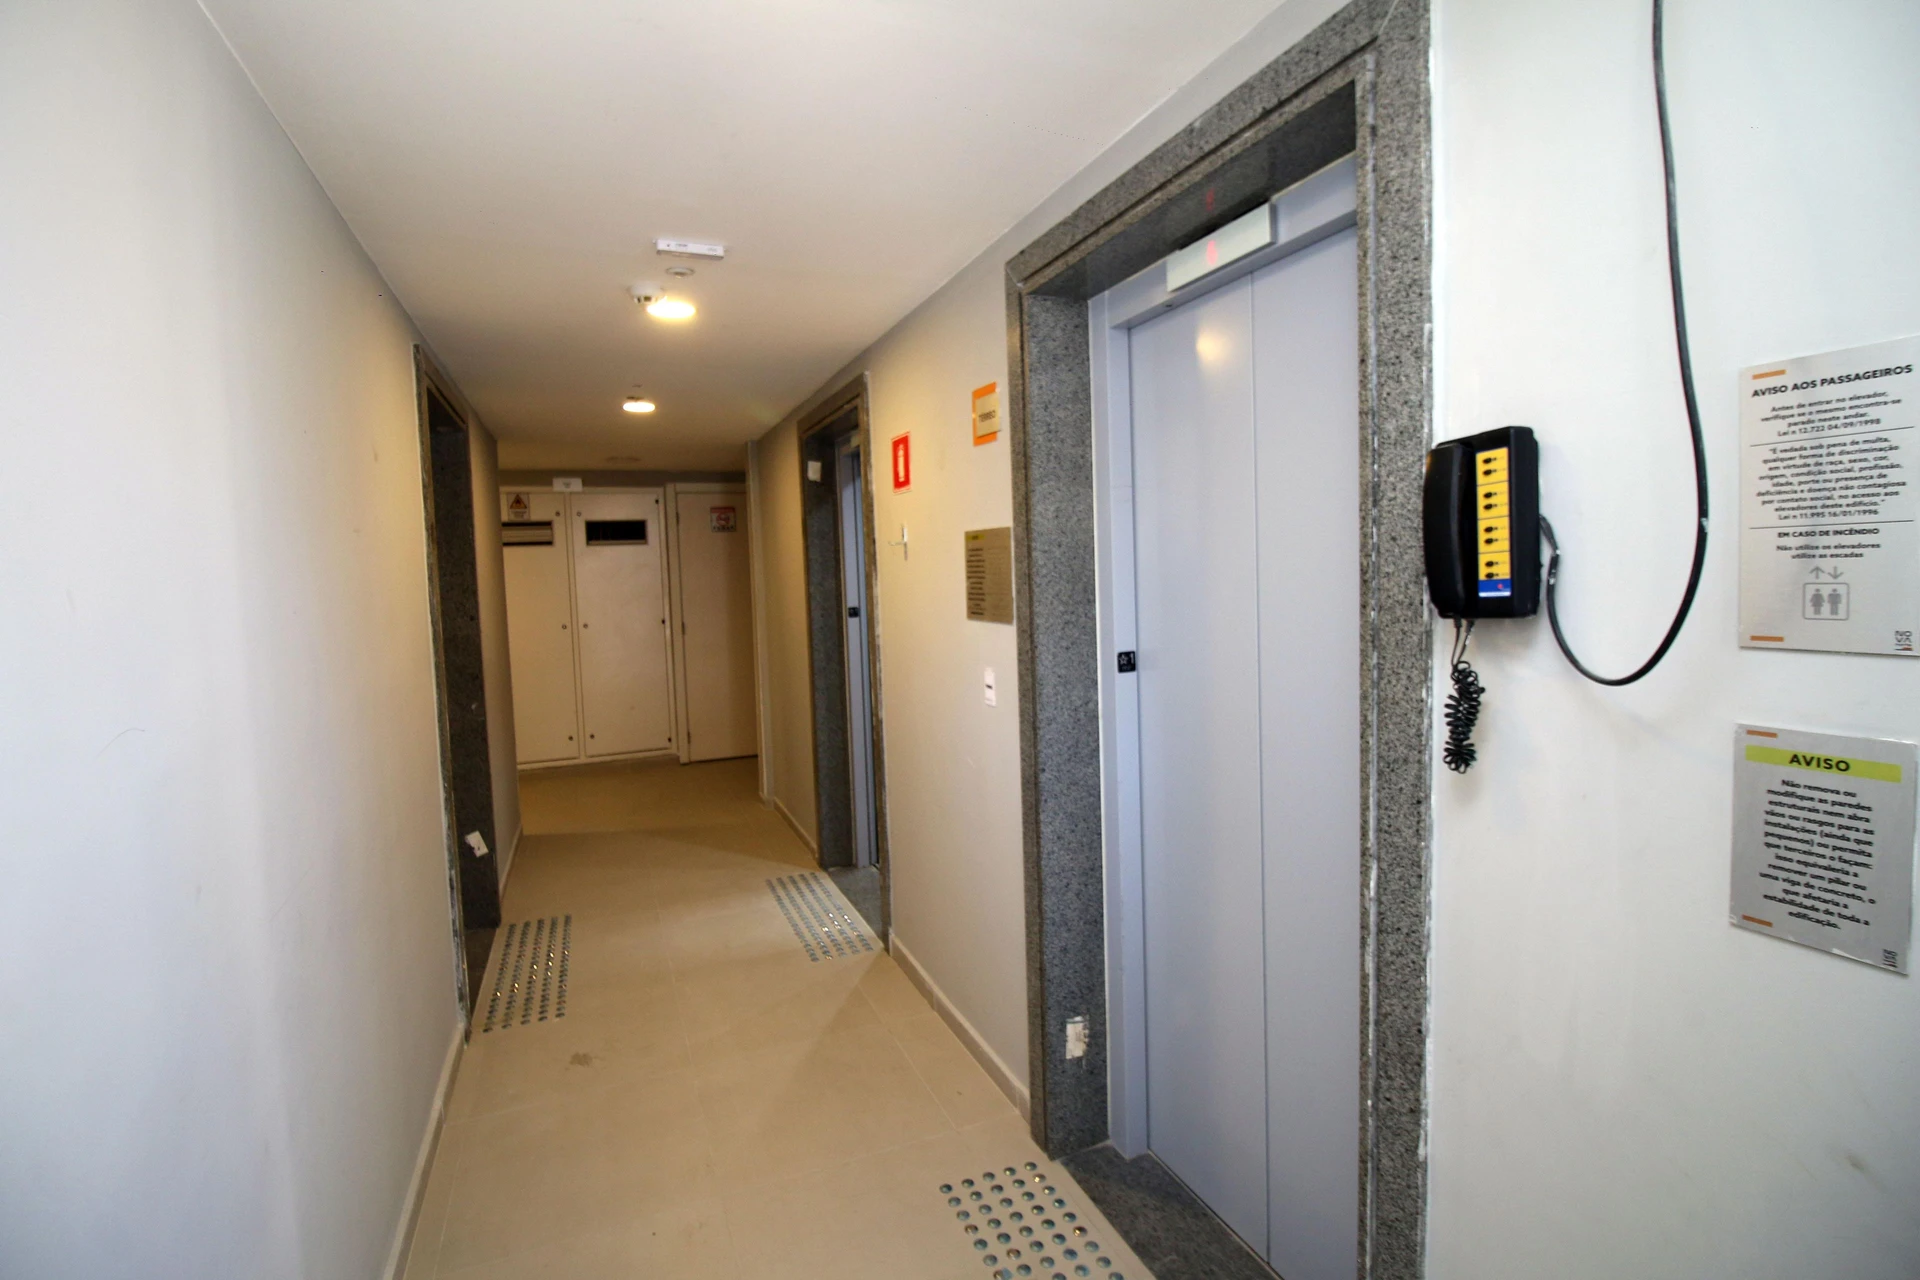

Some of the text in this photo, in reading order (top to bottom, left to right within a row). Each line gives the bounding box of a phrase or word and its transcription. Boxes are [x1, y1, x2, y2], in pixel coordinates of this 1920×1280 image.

[1752, 364, 1913, 397] AVISO AOS PASSAGEIROS
[1761, 413, 1795, 421] verifique
[1814, 406, 1846, 414] mesmo
[1848, 399, 1901, 410] encontra-se
[1807, 399, 1833, 407] entrar
[1787, 418, 1816, 428] parado
[1762, 456, 1797, 464] qualquer
[1837, 444, 1899, 456] discriminação
[1779, 445, 1807, 453] vedada
[1790, 469, 1827, 477] condição
[1834, 474, 1874, 483] presença
[1856, 481, 1906, 489] contagiosa
[1774, 504, 1817, 512] elevadores
[1832, 527, 1879, 535] INCÊNDIO
[1788, 753, 1850, 773] AVISO
[1781, 779, 1801, 788] Não
[1803, 784, 1840, 795] remova
[1766, 789, 1815, 802] modifique
[1830, 800, 1872, 811] paredes
[1764, 809, 1786, 818] vãos
[1801, 817, 1835, 827] rasgos
[1837, 823, 1860, 832] para
[1768, 800, 1870, 823] estruturais nem abra
[1764, 819, 1873, 846] instalações (ainda que
[1764, 831, 1814, 847] pequenos)
[1831, 845, 1872, 857] permita
[1783, 845, 1827, 859] terceiros
[1775, 853, 1794, 862] isso
[1795, 859, 1850, 875] equivaleria
[1759, 872, 1779, 881] uma
[1780, 876, 1801, 886] viga
[1802, 881, 1816, 890] de
[1767, 863, 1808, 876] remover
[1809, 873, 1825, 881] um
[1827, 877, 1850, 886] pilar
[1782, 888, 1800, 896] que
[1802, 892, 1841, 907] afetaria
[1763, 894, 1820, 912] estabilidade
[1821, 908, 1835, 916] de
[1836, 912, 1861, 923] toda
